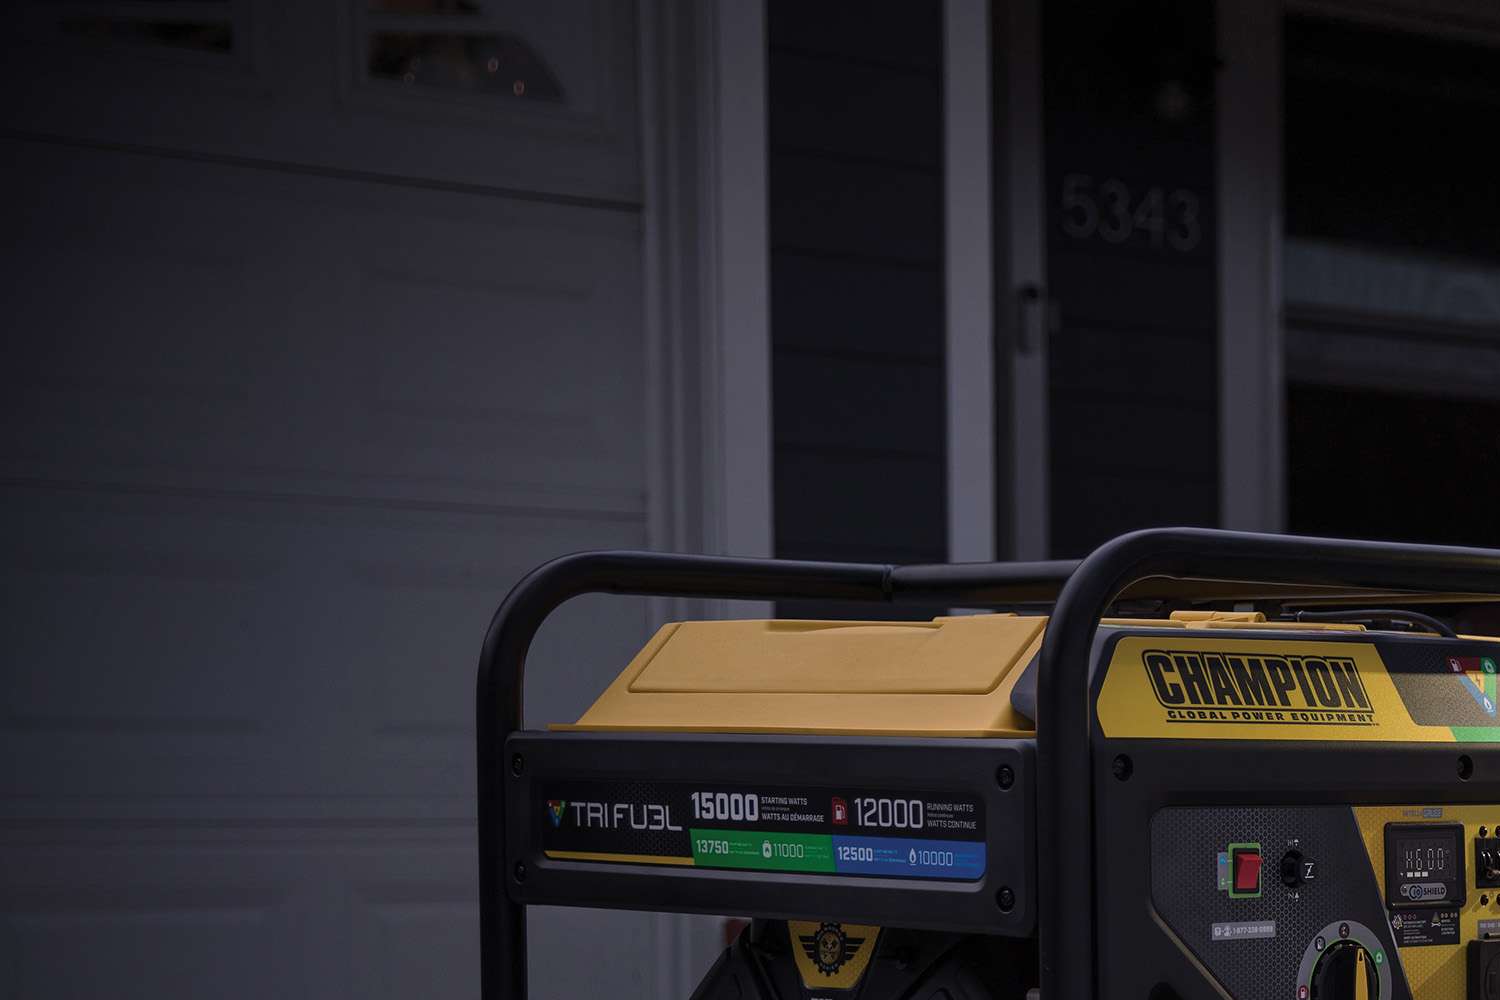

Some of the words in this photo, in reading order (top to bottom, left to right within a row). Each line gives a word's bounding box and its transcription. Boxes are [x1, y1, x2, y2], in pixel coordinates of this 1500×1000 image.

[1063, 172, 1201, 252] 5343
[1146, 653, 1370, 709] CHAMPION
[1168, 710, 1227, 720] GLOBAL
[1233, 711, 1285, 721] POWER
[1292, 713, 1375, 723] EQUIPMENT
[691, 792, 759, 821] 15000
[761, 797, 788, 805] STARTING
[789, 798, 808, 806] WATTS
[927, 803, 952, 813] RUNNING
[954, 804, 974, 813] WATTS
[762, 813, 781, 821] WATTS
[854, 798, 924, 829] 12000
[927, 820, 947, 829] WATTS
[948, 820, 977, 831] CONTINUE
[696, 840, 729, 855] 13750
[773, 843, 804, 858] 11000
[838, 846, 873, 863] 12500
[919, 851, 953, 867] 10000
